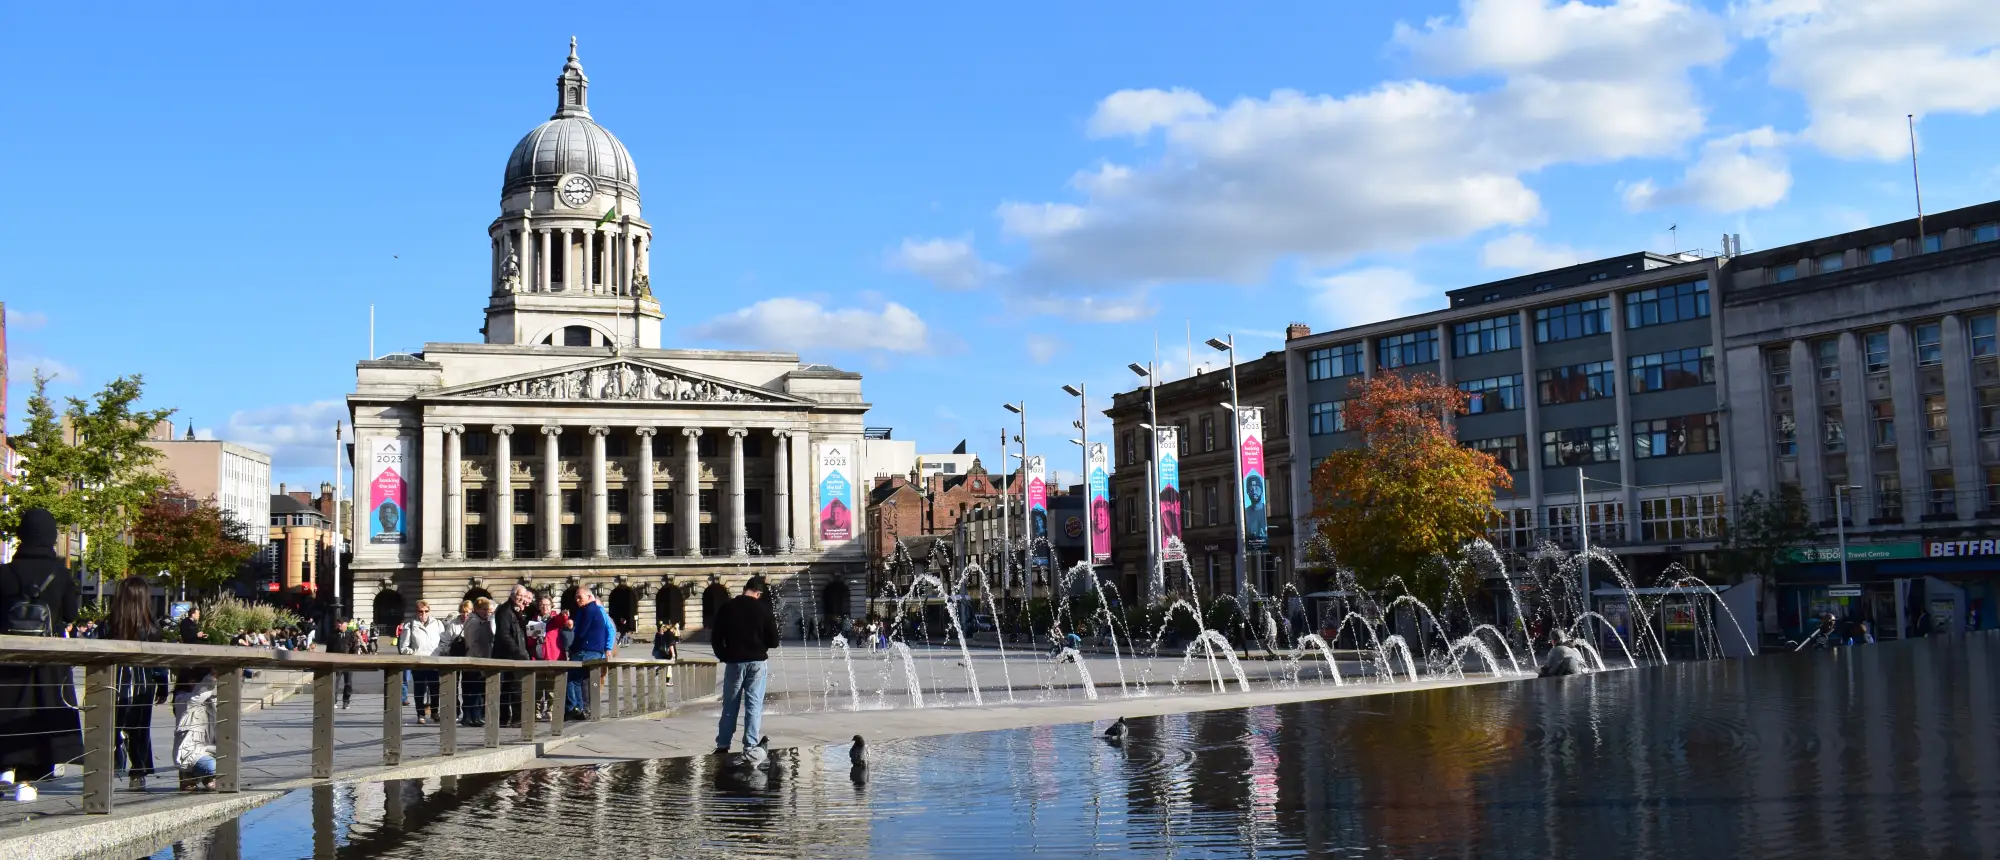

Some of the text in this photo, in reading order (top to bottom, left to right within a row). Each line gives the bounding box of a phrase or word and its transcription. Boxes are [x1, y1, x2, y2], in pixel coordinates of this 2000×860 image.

[376, 455, 403, 463] 2023
[823, 458, 846, 466] 2023
[1803, 551, 1841, 561] Transpo
